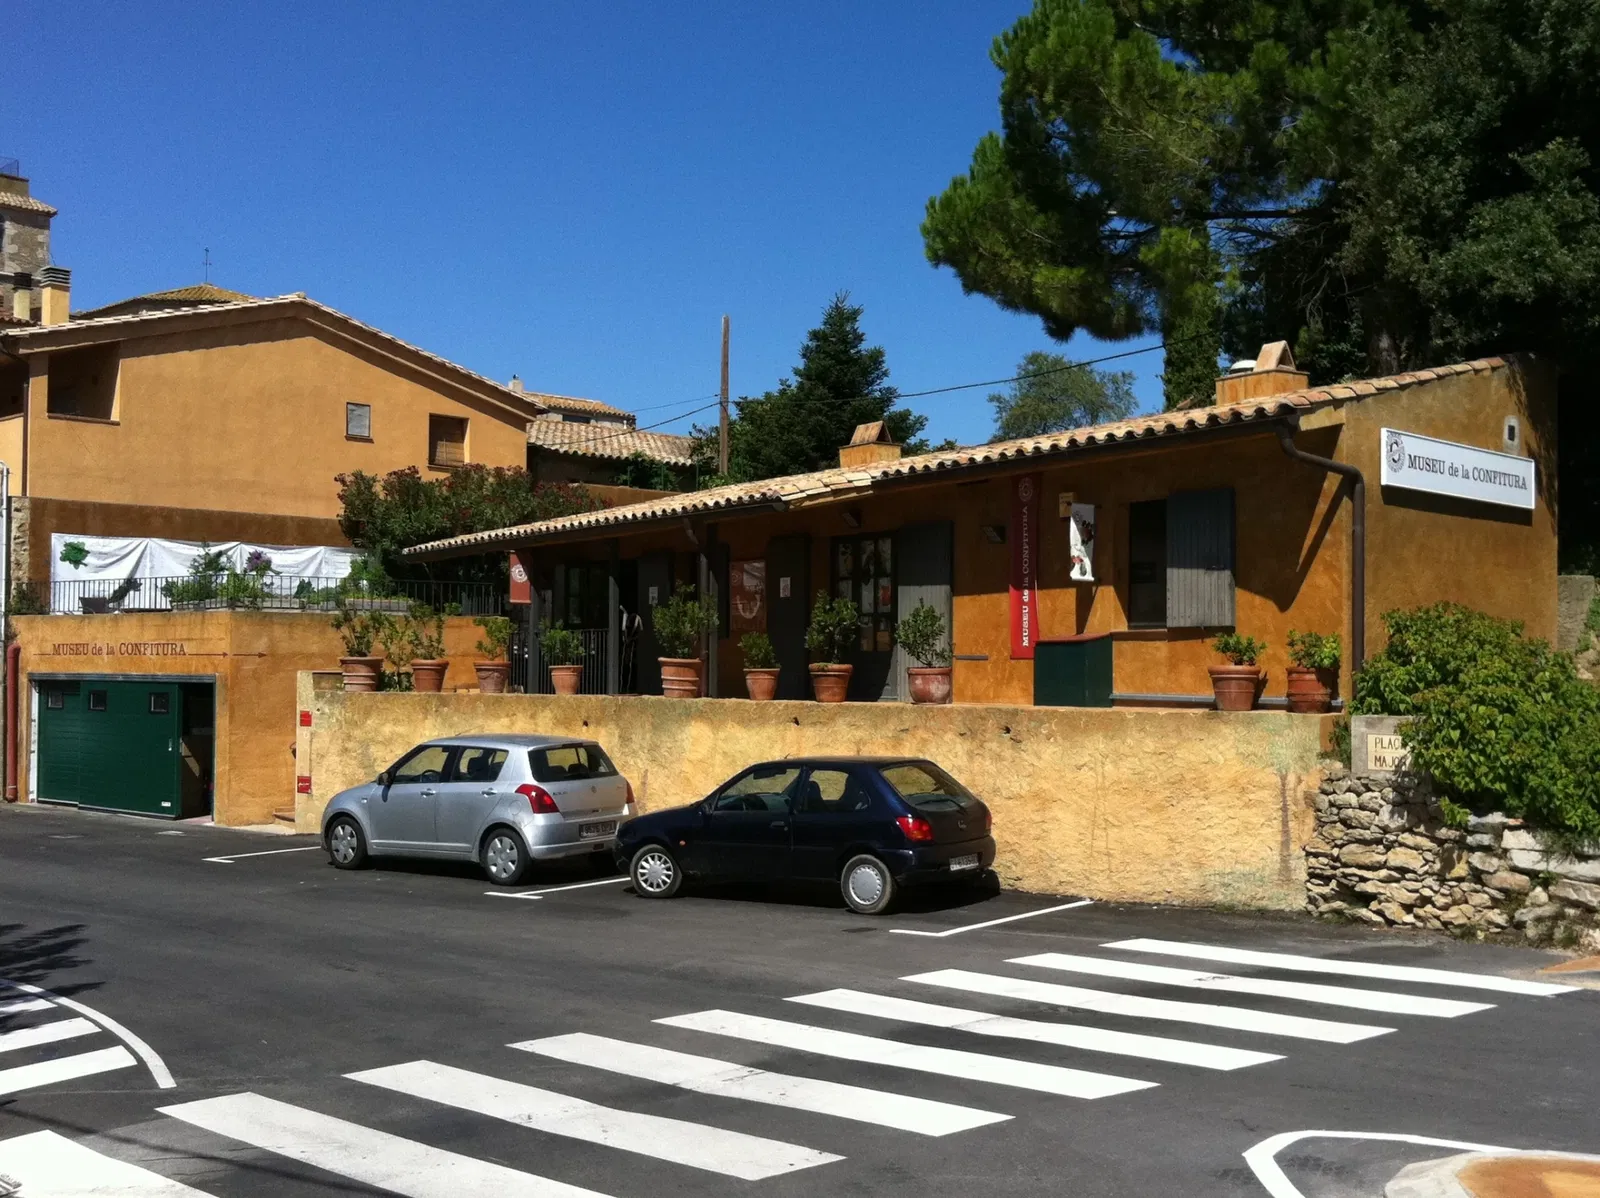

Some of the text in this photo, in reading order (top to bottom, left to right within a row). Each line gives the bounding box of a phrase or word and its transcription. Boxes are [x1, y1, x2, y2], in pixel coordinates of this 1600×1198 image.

[1408, 454, 1527, 490] MUSEU de la CONFITURA
[1022, 589, 1029, 602] de
[52, 642, 186, 656] MUSEU de la CONFITURA
[1374, 737, 1401, 751] PLAC
[1374, 755, 1401, 768] MAJO
